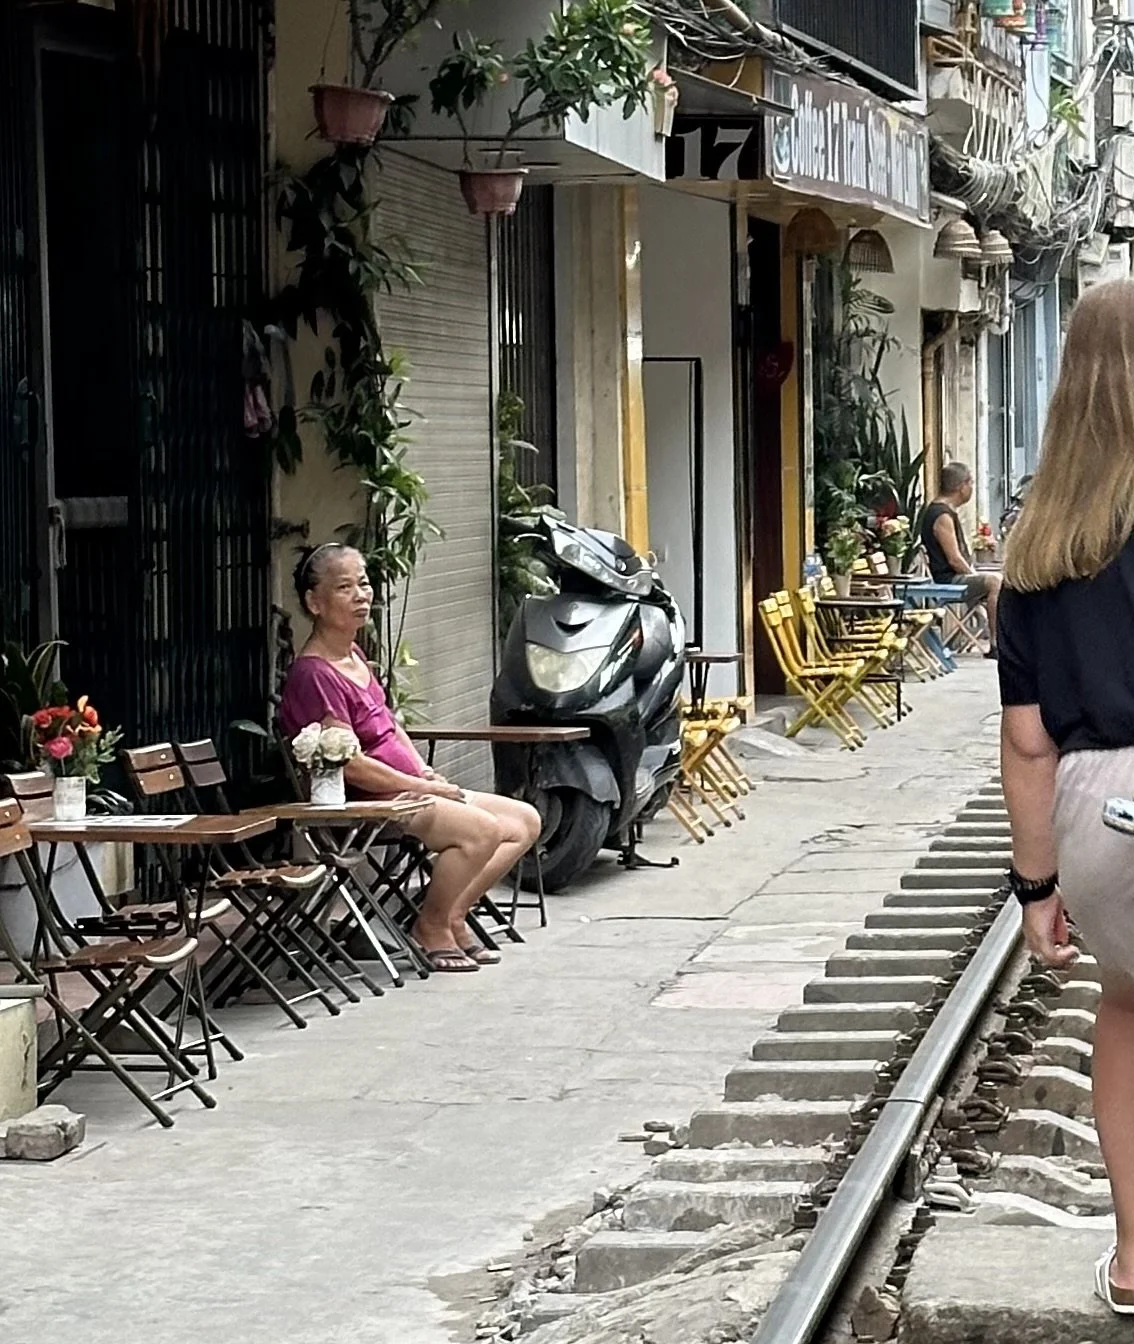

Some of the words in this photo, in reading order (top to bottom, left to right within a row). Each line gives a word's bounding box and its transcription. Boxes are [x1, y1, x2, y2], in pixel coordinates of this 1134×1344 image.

[675, 126, 753, 180] 17
[791, 83, 825, 181] Coffee
[826, 99, 840, 183] 17
[841, 102, 866, 190] Train
